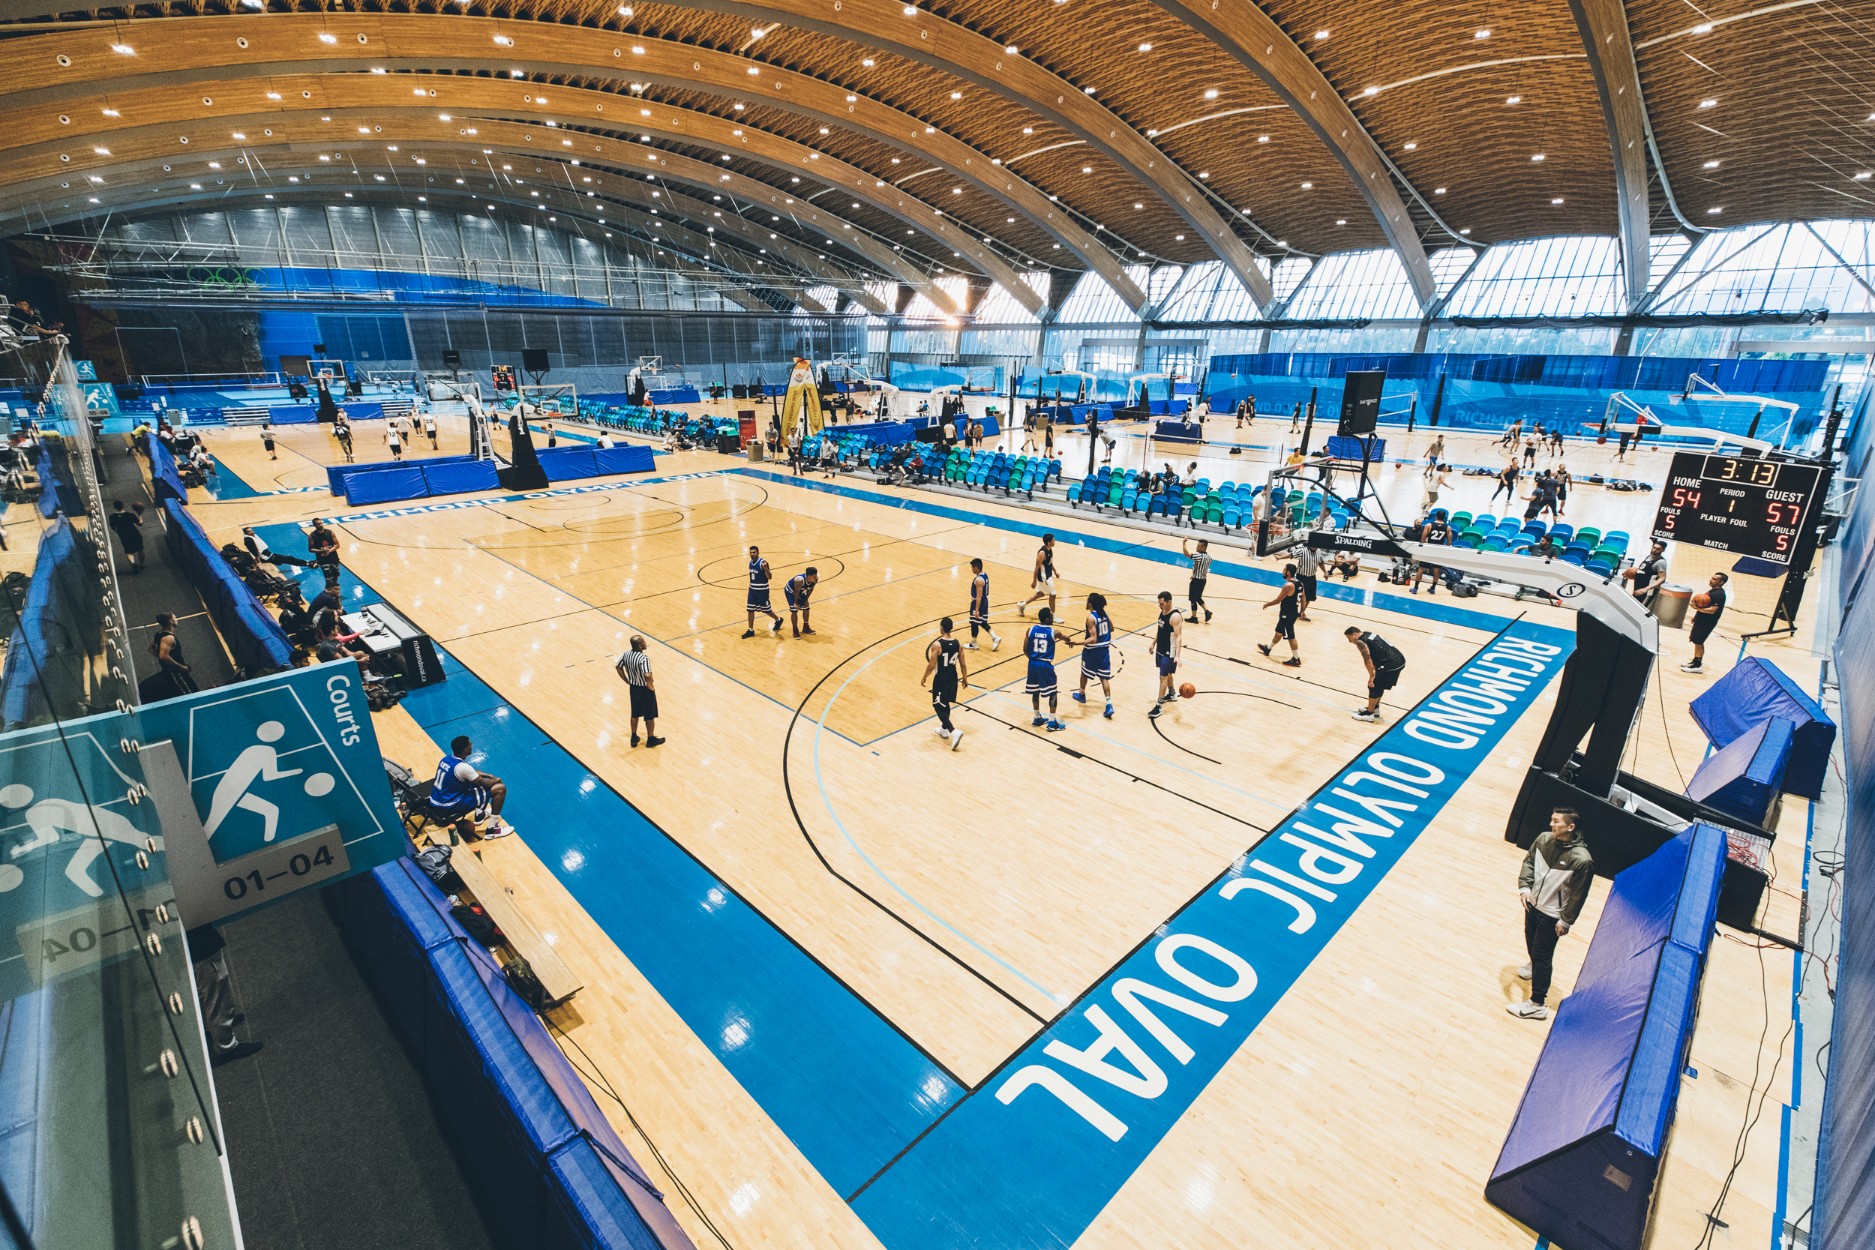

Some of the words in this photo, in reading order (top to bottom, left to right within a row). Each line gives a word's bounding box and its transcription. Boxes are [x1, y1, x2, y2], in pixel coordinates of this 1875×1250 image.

[1721, 459, 1775, 485] 3:13
[522, 479, 654, 500] OLYMPIC
[1672, 476, 1702, 489] HOME
[1672, 488, 1701, 510] 54
[1719, 488, 1746, 498] PERIOD
[1765, 489, 1805, 503] GUEST
[1660, 506, 1681, 516] FOULS
[1728, 499, 1736, 513] 1
[1766, 502, 1801, 525] 57
[1664, 515, 1676, 530] 5
[1700, 513, 1727, 524] PLAYER
[1729, 518, 1749, 528] FOUL
[1430, 530, 1446, 541] 27
[1654, 529, 1675, 539] SCORE
[1770, 525, 1796, 536] FOULS
[1334, 535, 1373, 549] SPALDING
[1703, 539, 1729, 550] MATCH
[1776, 534, 1789, 551] 5
[1761, 550, 1787, 562] SCORE
[1098, 621, 1109, 636] 10
[1033, 638, 1048, 653] 13
[413, 640, 427, 682] richmondoval.ca
[942, 652, 960, 667] 14
[1403, 636, 1562, 750] RICHMOND
[326, 674, 361, 746] Courts
[434, 769, 446, 790] 11
[1219, 752, 1445, 934] OLYMPIC
[995, 934, 1258, 1142] OVAL
